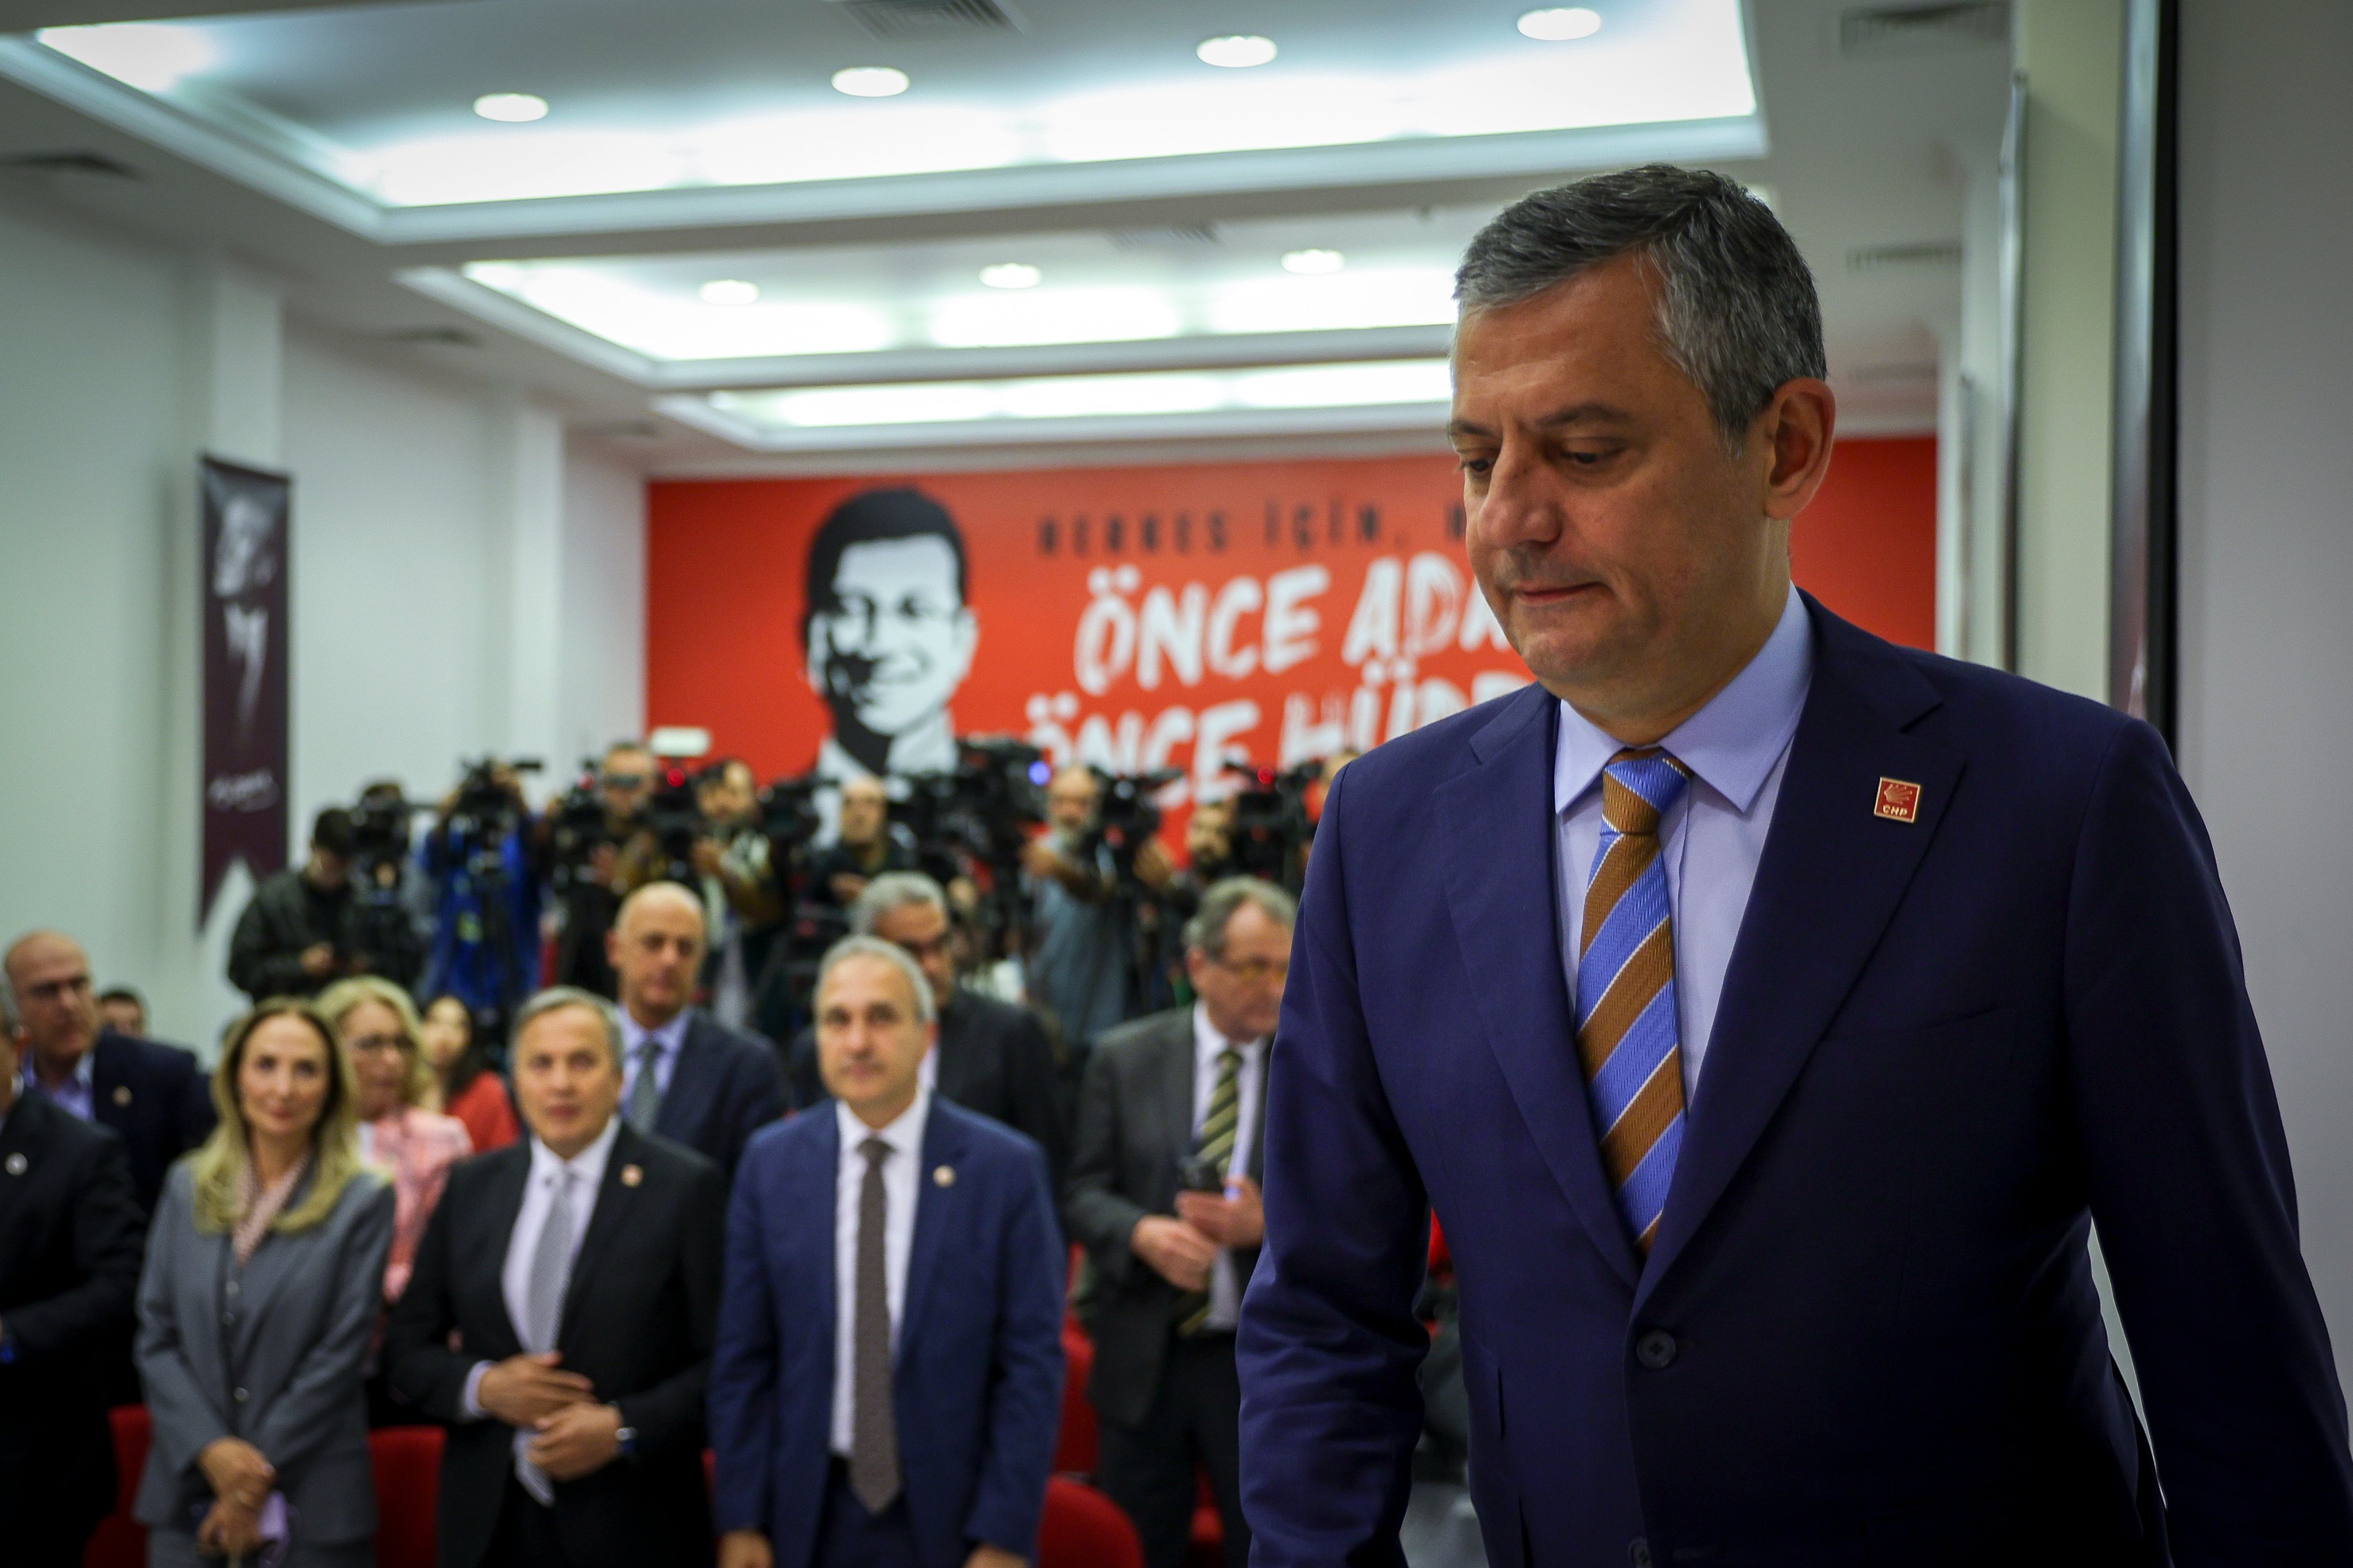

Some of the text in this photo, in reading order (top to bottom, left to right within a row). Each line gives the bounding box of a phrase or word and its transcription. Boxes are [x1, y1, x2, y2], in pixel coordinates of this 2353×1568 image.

[1074, 563, 1330, 696] ÖNCE
[1026, 698, 1260, 805] ÖNCE
[1883, 805, 1907, 817] CHP
